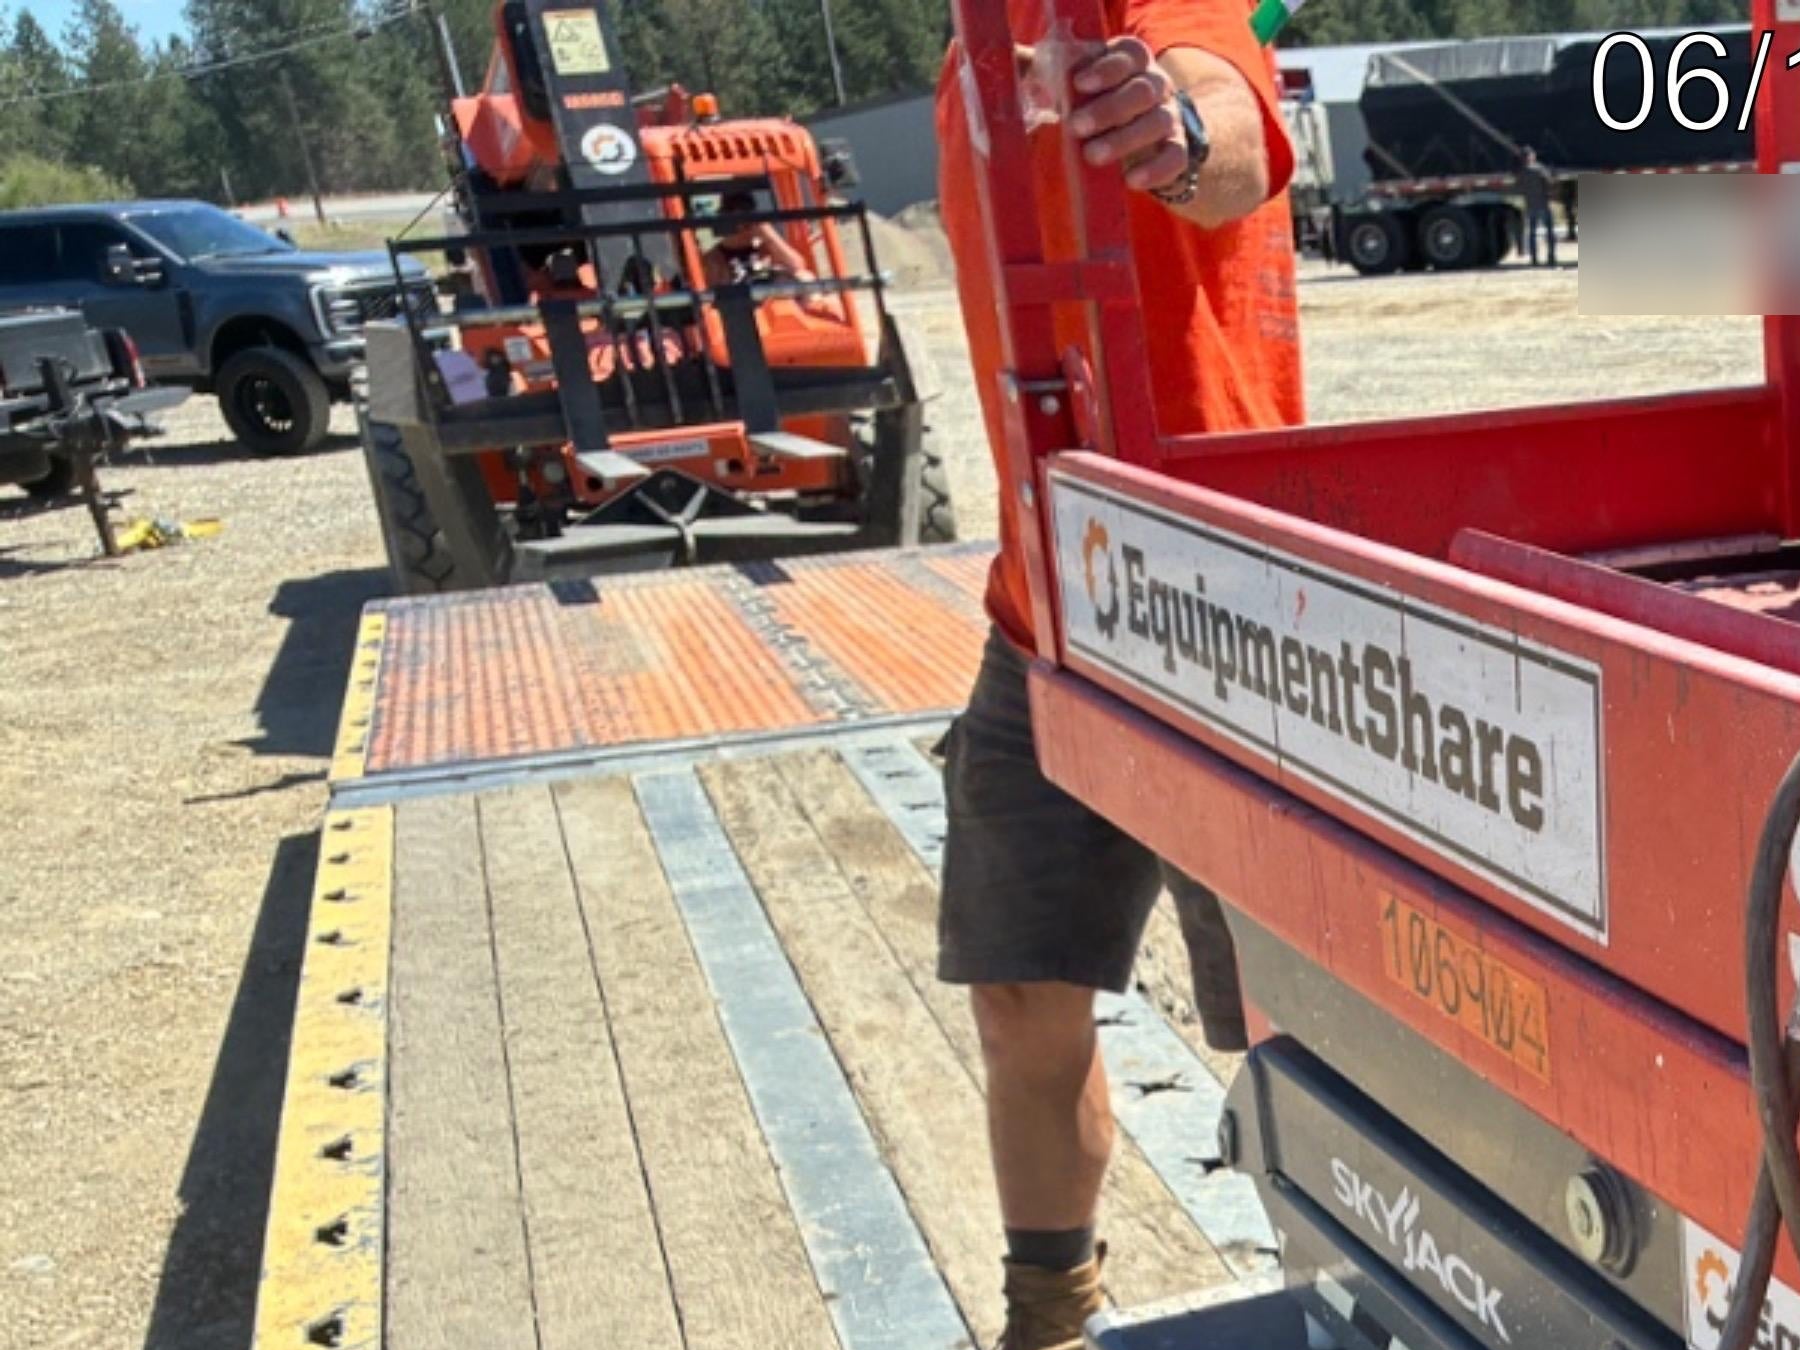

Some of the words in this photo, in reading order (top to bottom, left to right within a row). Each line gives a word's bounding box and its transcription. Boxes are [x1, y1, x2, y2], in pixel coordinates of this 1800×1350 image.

[1121, 544, 1544, 834] EquipmentShare
[1384, 898, 1546, 1073] 106904
[1331, 1157, 1512, 1344] SKYJACK
